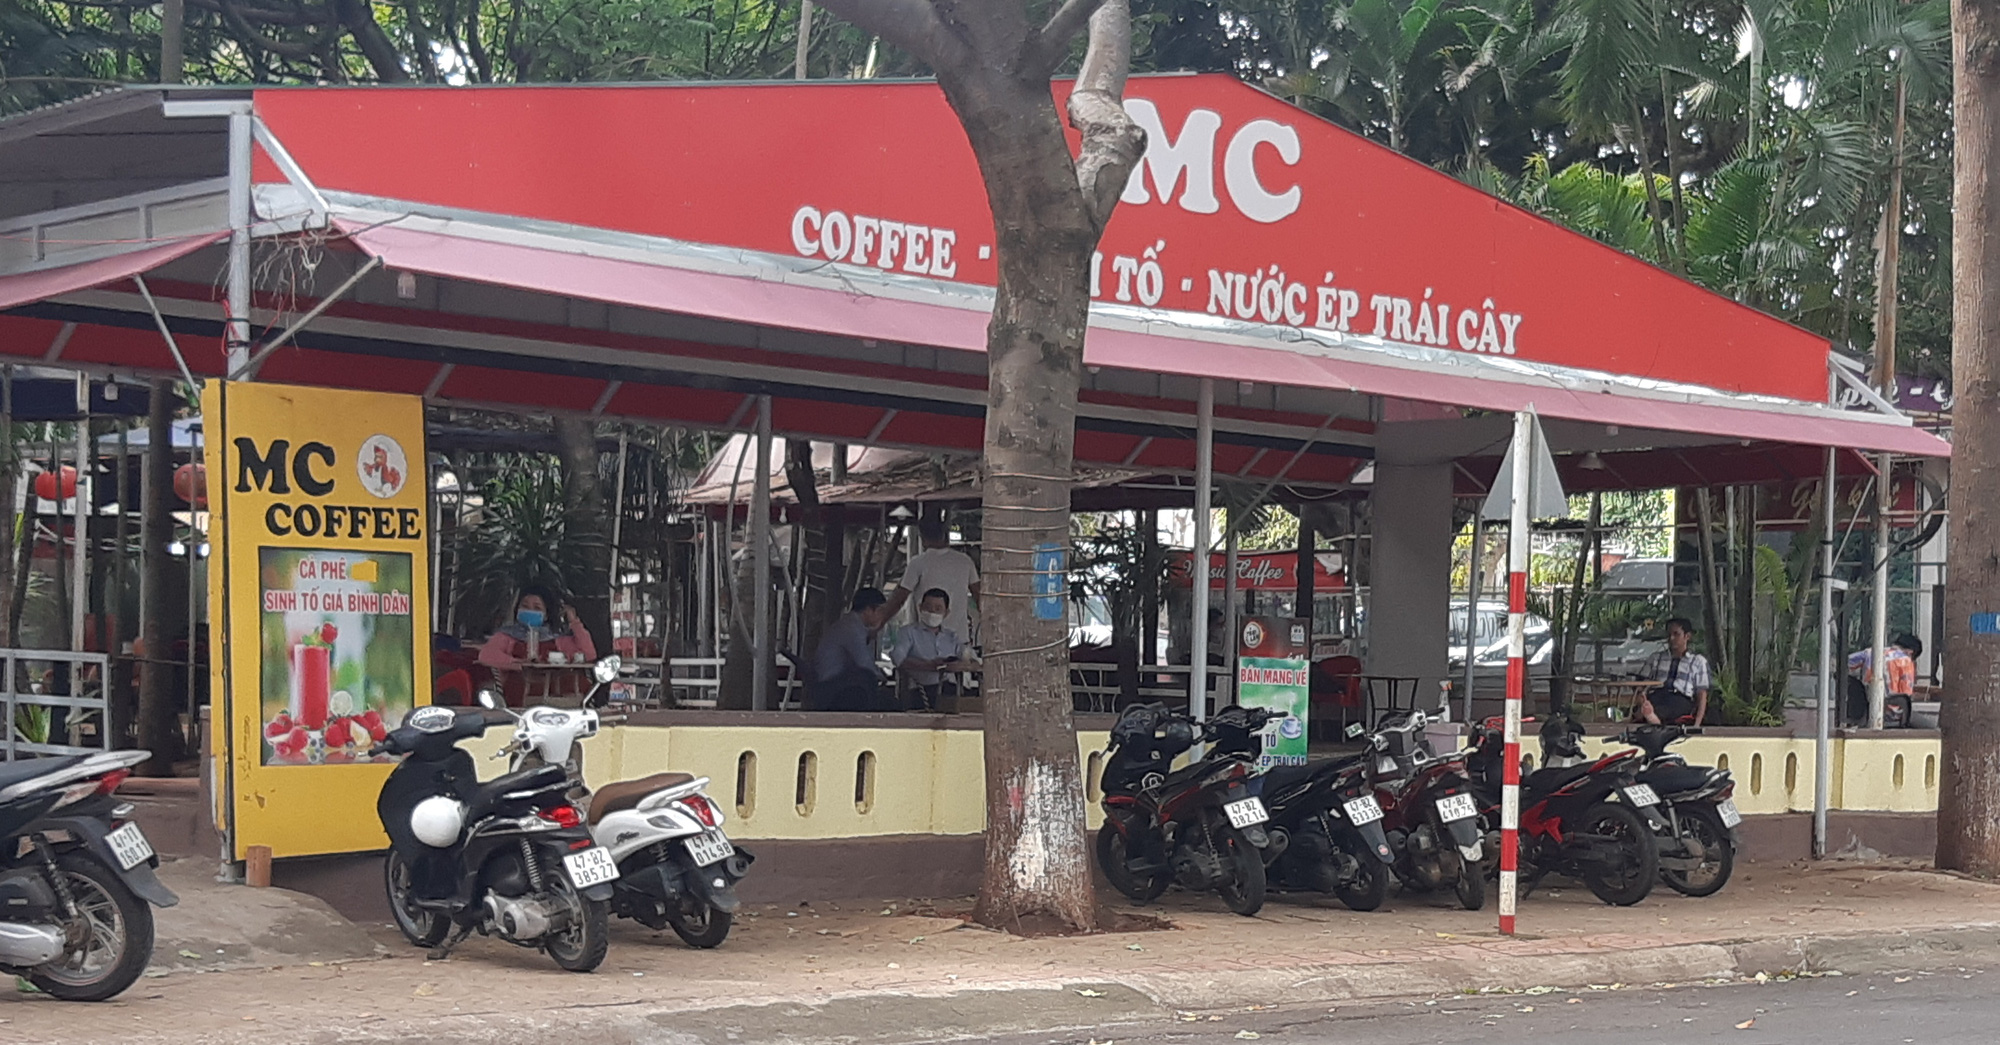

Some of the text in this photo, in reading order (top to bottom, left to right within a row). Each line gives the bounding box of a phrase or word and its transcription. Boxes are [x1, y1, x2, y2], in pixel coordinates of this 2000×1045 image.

[1122, 98, 1300, 222] MC
[792, 206, 956, 278] COFFEE
[1113, 240, 1166, 306] TỐ
[1207, 264, 1307, 326] NƯỚC
[1315, 271, 1359, 331] ÉP
[1370, 287, 1450, 346] TRÁI
[1457, 298, 1522, 355] CÂY
[234, 437, 336, 496] MC
[265, 503, 421, 540] COFFEE
[320, 558, 347, 581] PHÊ
[1236, 559, 1284, 586] Caffee
[265, 591, 297, 612] SINH
[301, 586, 320, 612] TỐ
[322, 588, 345, 613] GIÁ
[348, 588, 380, 614] BÌNH
[1263, 668, 1294, 685] MANG
[1230, 800, 1258, 815] 47-BZ
[573, 850, 607, 870] 47-BZ
[574, 862, 615, 886] 385.27
